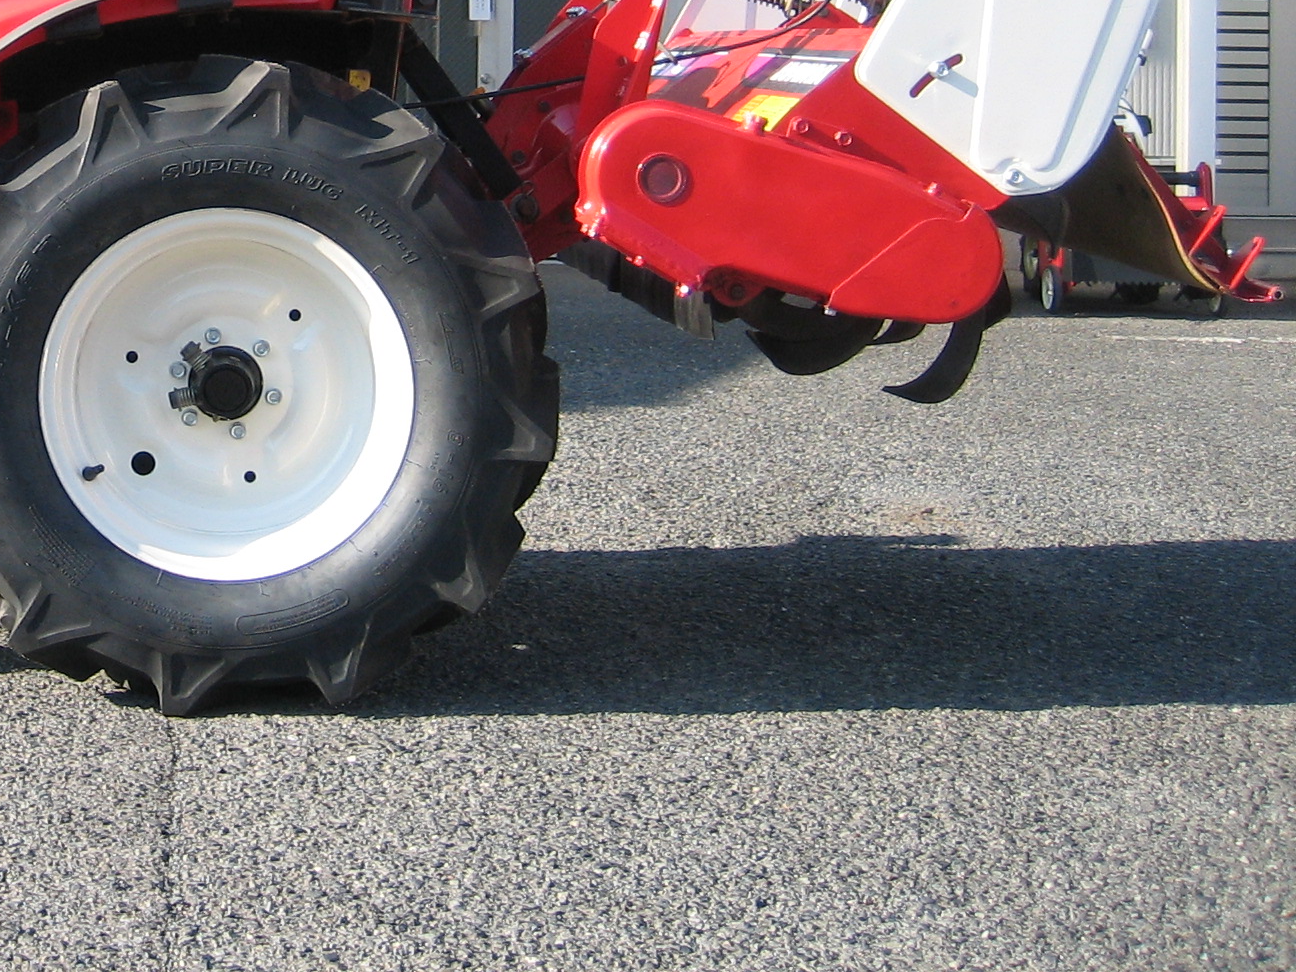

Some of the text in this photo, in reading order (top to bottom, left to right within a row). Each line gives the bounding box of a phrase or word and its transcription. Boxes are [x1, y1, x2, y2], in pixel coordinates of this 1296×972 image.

[161, 158, 274, 181] SUPER
[282, 166, 344, 201] LUG
[432, 428, 464, 495] 8-16
